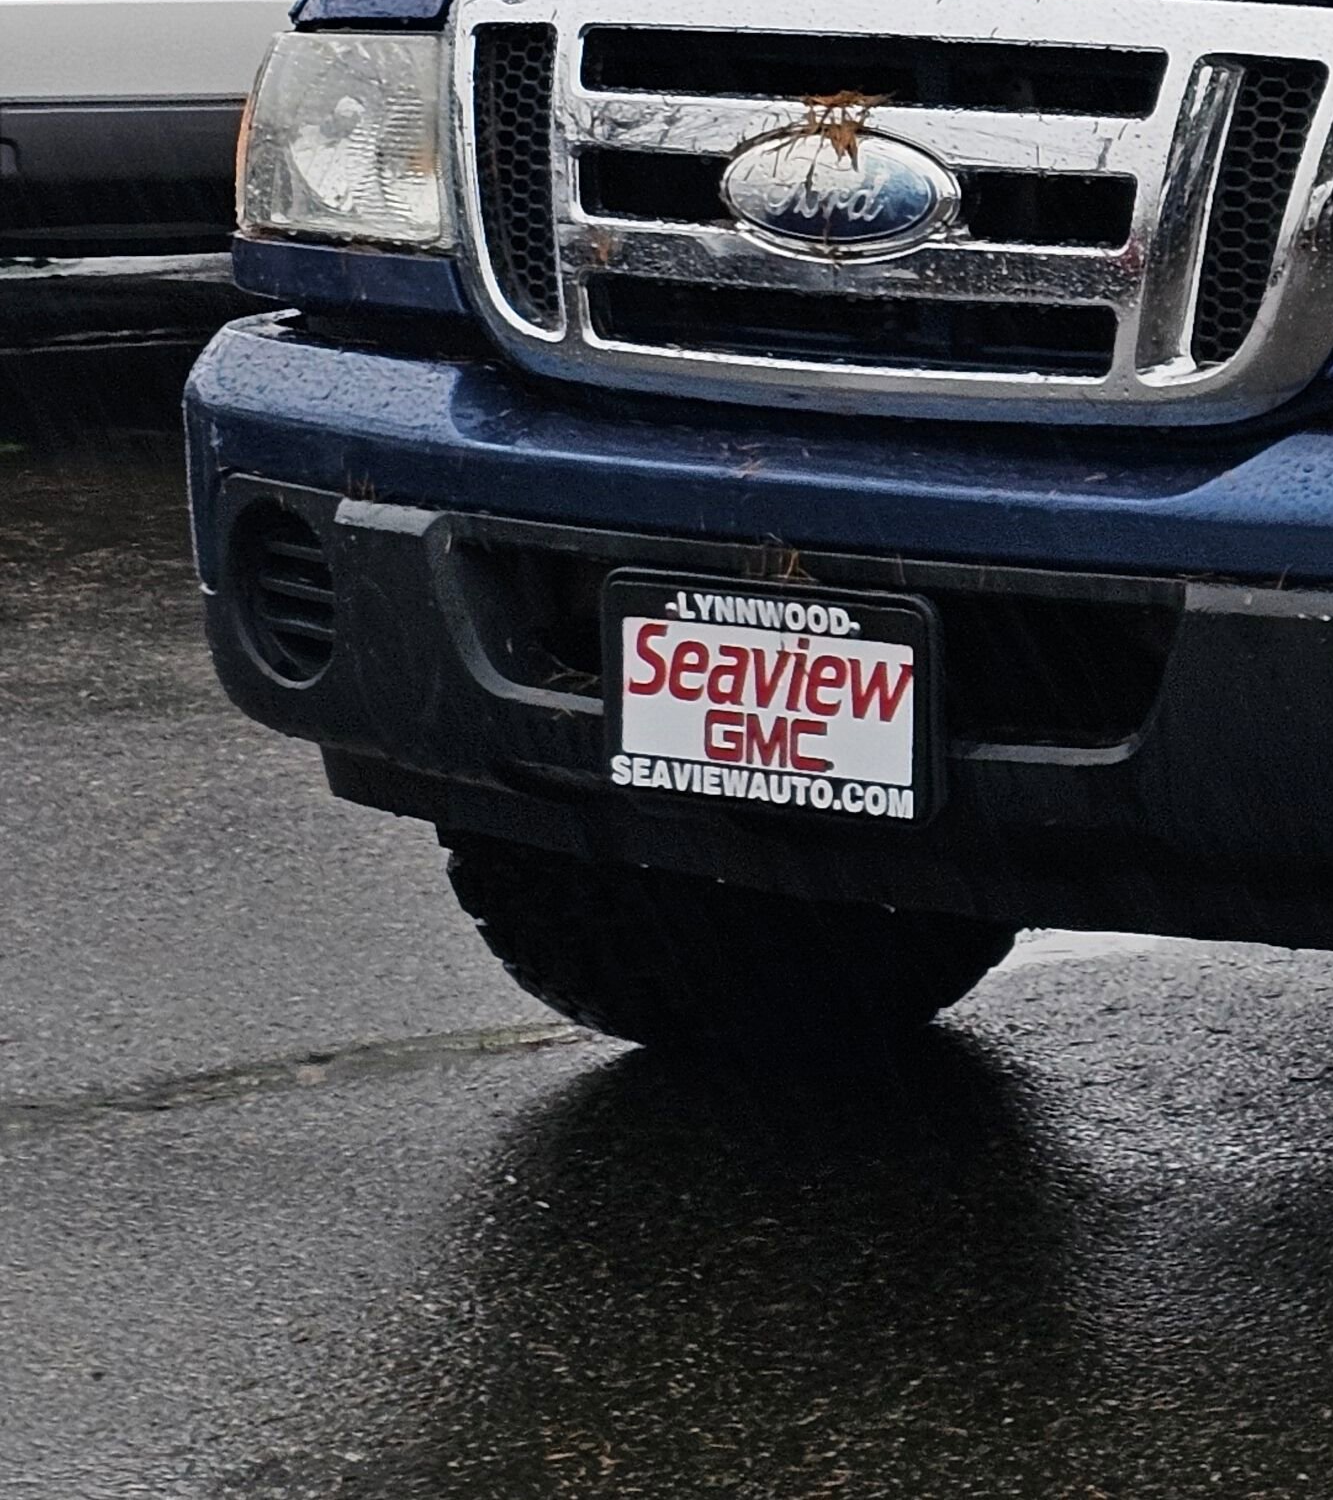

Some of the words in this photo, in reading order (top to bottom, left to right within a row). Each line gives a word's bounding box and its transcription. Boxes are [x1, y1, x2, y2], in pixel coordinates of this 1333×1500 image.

[677, 591, 852, 636] LYNNWOOD
[629, 622, 914, 723] Seaview
[704, 708, 832, 773] GMC
[611, 754, 914, 821] SEAVIEWAUTO.COM
